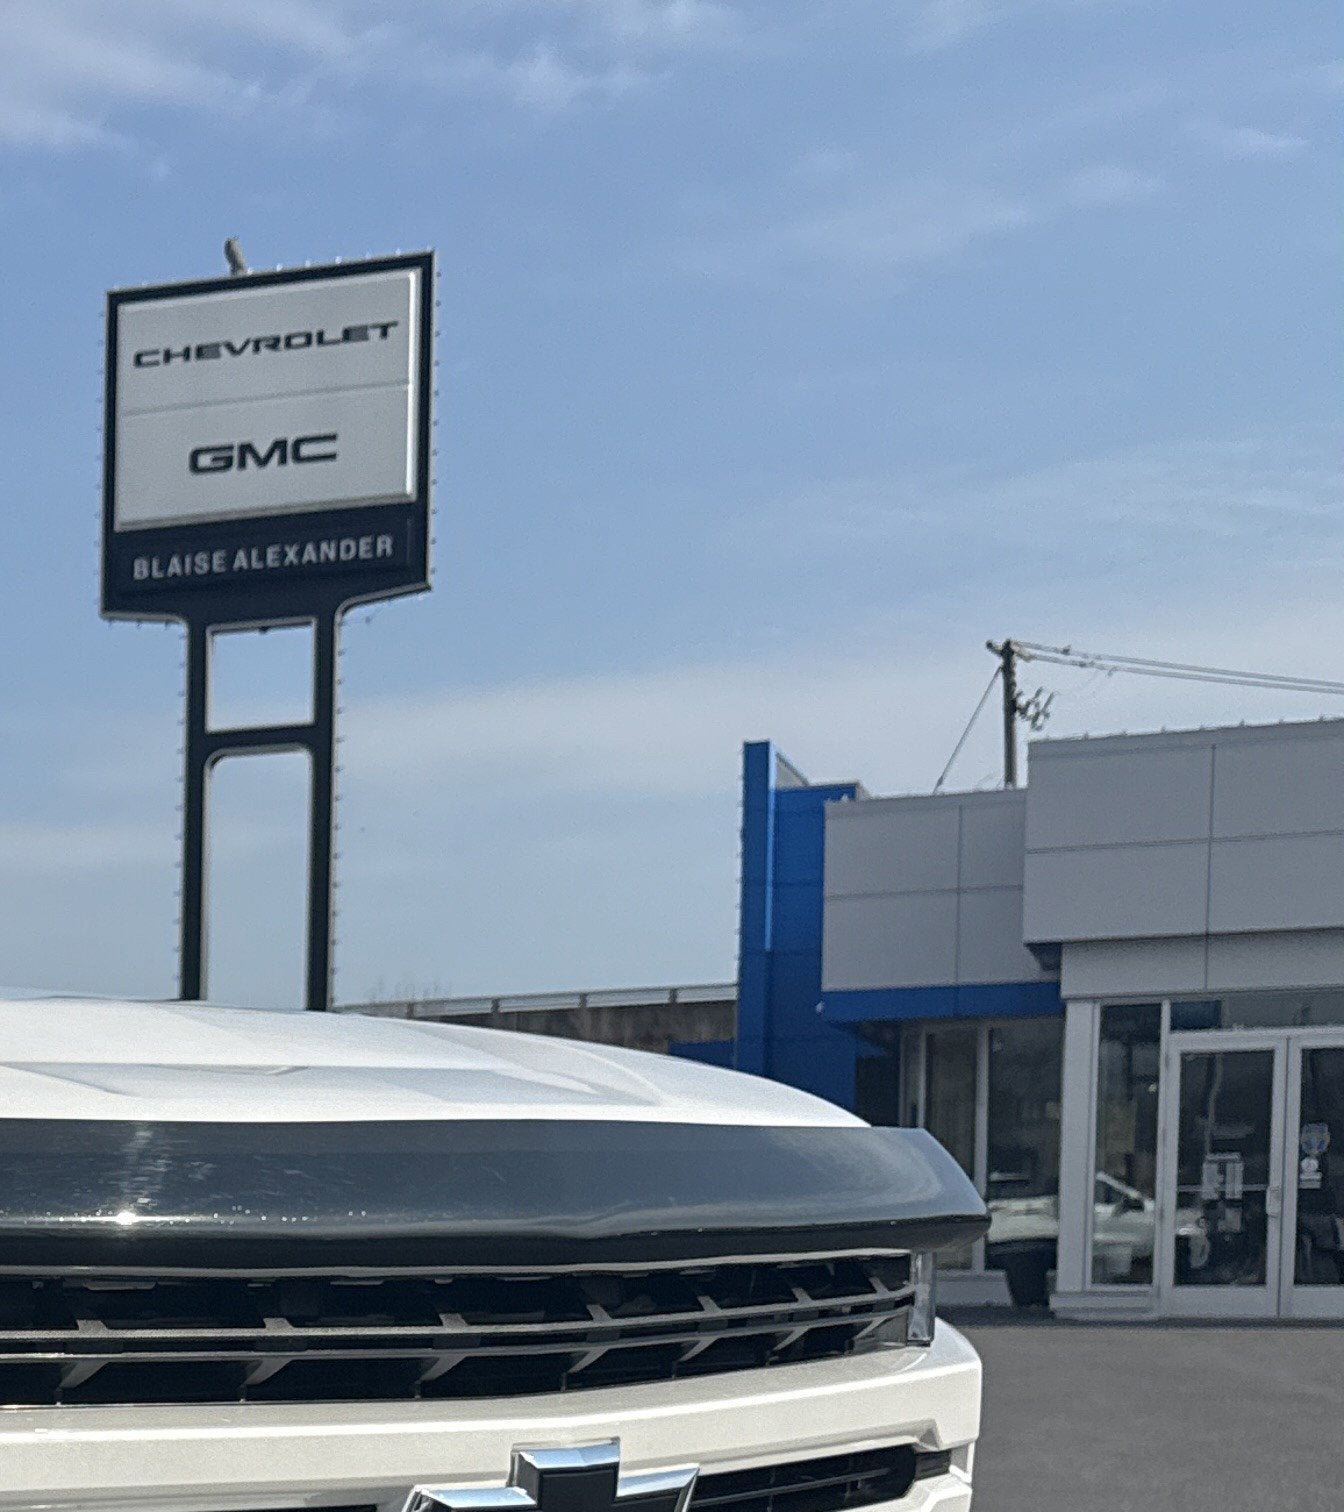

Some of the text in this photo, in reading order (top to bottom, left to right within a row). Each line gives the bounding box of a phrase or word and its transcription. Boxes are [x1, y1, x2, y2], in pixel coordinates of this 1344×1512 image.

[132, 320, 399, 369] CHEVROLET
[188, 433, 338, 476] GMC
[132, 533, 394, 581] BLAISE ALEXANDER
